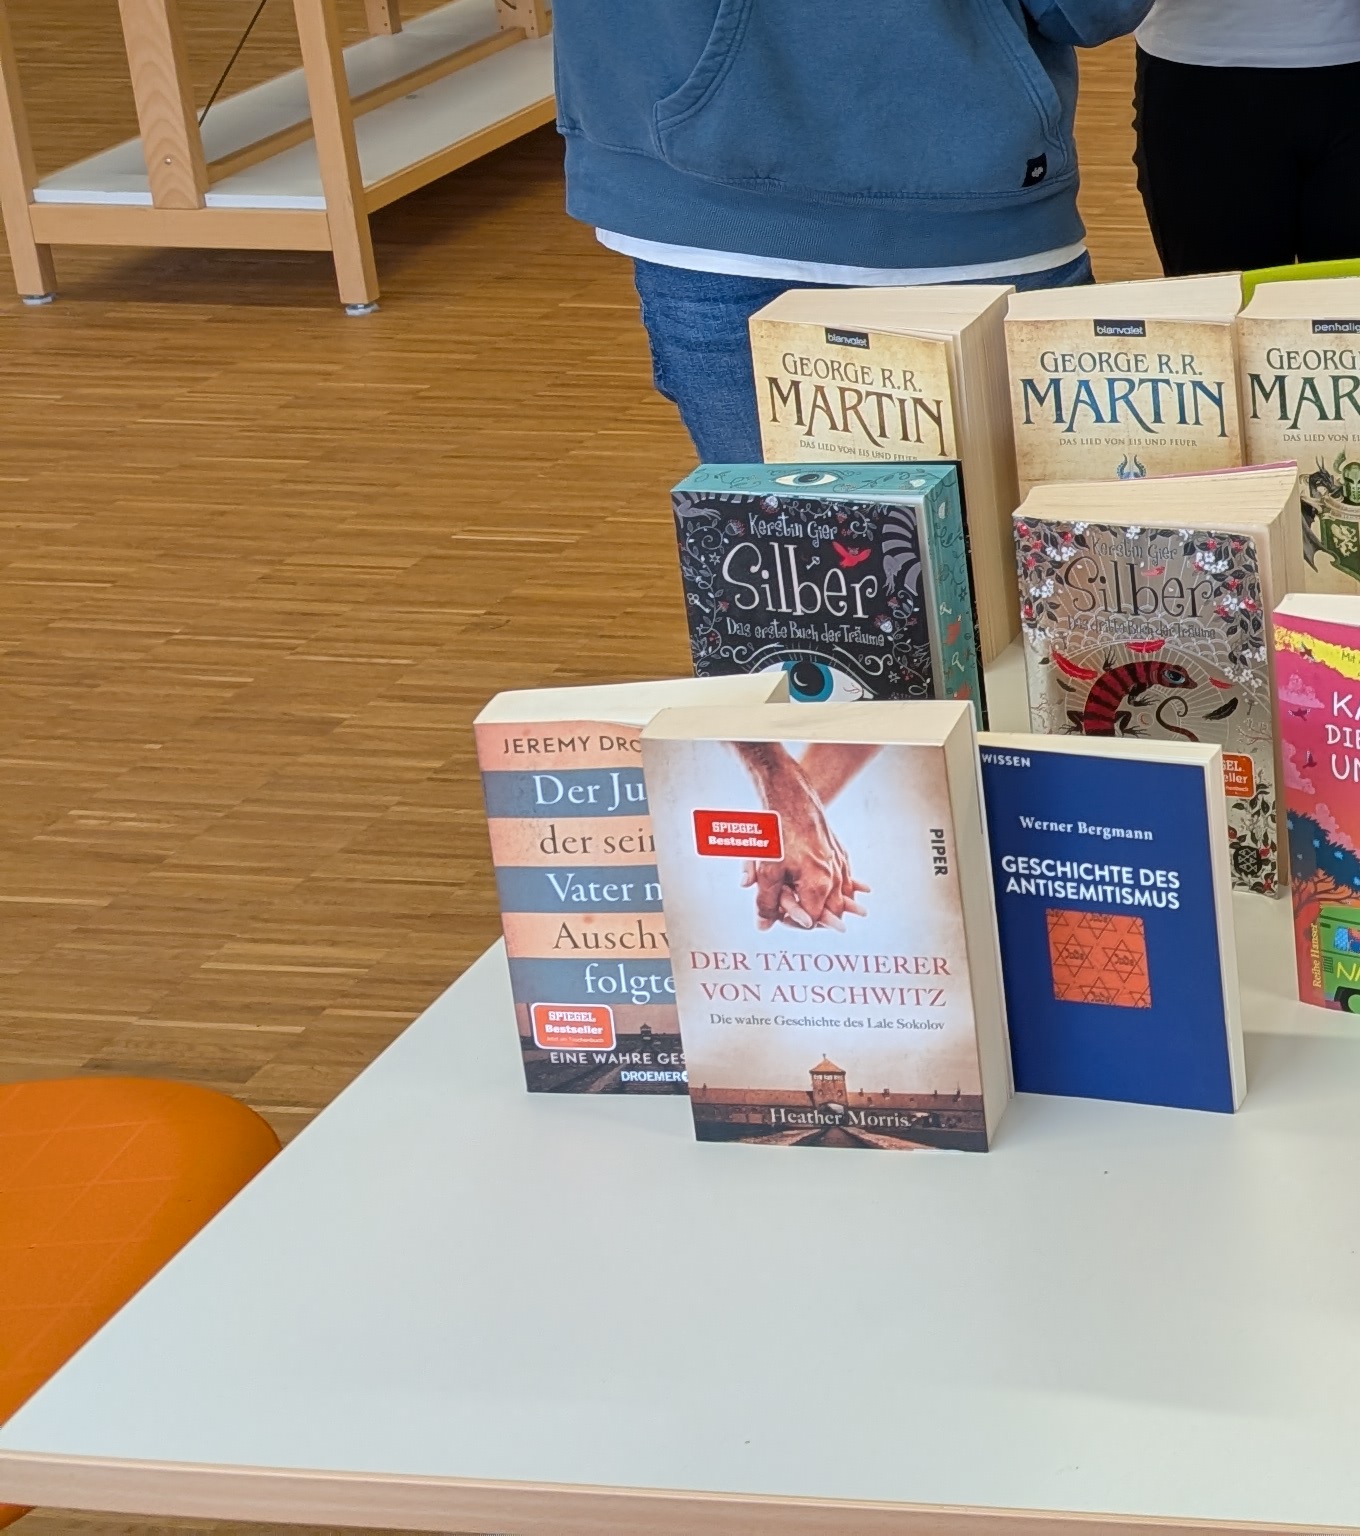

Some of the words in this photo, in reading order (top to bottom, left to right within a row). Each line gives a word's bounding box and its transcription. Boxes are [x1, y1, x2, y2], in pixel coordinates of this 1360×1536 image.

[1096, 324, 1144, 336] blanvalet
[1040, 351, 1150, 373] GEORGE
[1158, 354, 1202, 376] R.R.
[1019, 377, 1228, 438] MARTIN
[749, 513, 803, 538] Kerstin
[808, 521, 838, 547] Gier
[722, 542, 878, 618] Silber
[1064, 556, 1213, 618] Silber
[726, 617, 751, 637] Das
[755, 619, 787, 638] erste
[790, 621, 819, 641] Buch
[821, 623, 842, 643] der
[841, 625, 885, 646] Träume
[1341, 649, 1356, 662] Mit
[981, 752, 1031, 768] WISSEN
[712, 821, 762, 835] SPIEGEL
[1019, 815, 1073, 834] Werner
[1078, 821, 1154, 841] Bergmann
[708, 835, 770, 849] Bestseller
[929, 828, 948, 877] PIPER
[1002, 856, 1134, 885] GESCHICHTE
[1140, 868, 1180, 889] DES
[1006, 876, 1180, 910] ANTISEMITISMUS
[691, 950, 751, 972] DER
[755, 949, 951, 976] TÄTOWIERER
[700, 982, 761, 1002] VON
[770, 984, 947, 1008] AUSCHWITZ
[710, 1013, 732, 1025] Die
[734, 1015, 772, 1026] wahre
[774, 1016, 841, 1029] Geschichte
[843, 1017, 864, 1029] des
[867, 1018, 894, 1029] Lale
[896, 1018, 945, 1031] Sokolov
[770, 1108, 842, 1126] Heather
[848, 1110, 909, 1128] Morris
